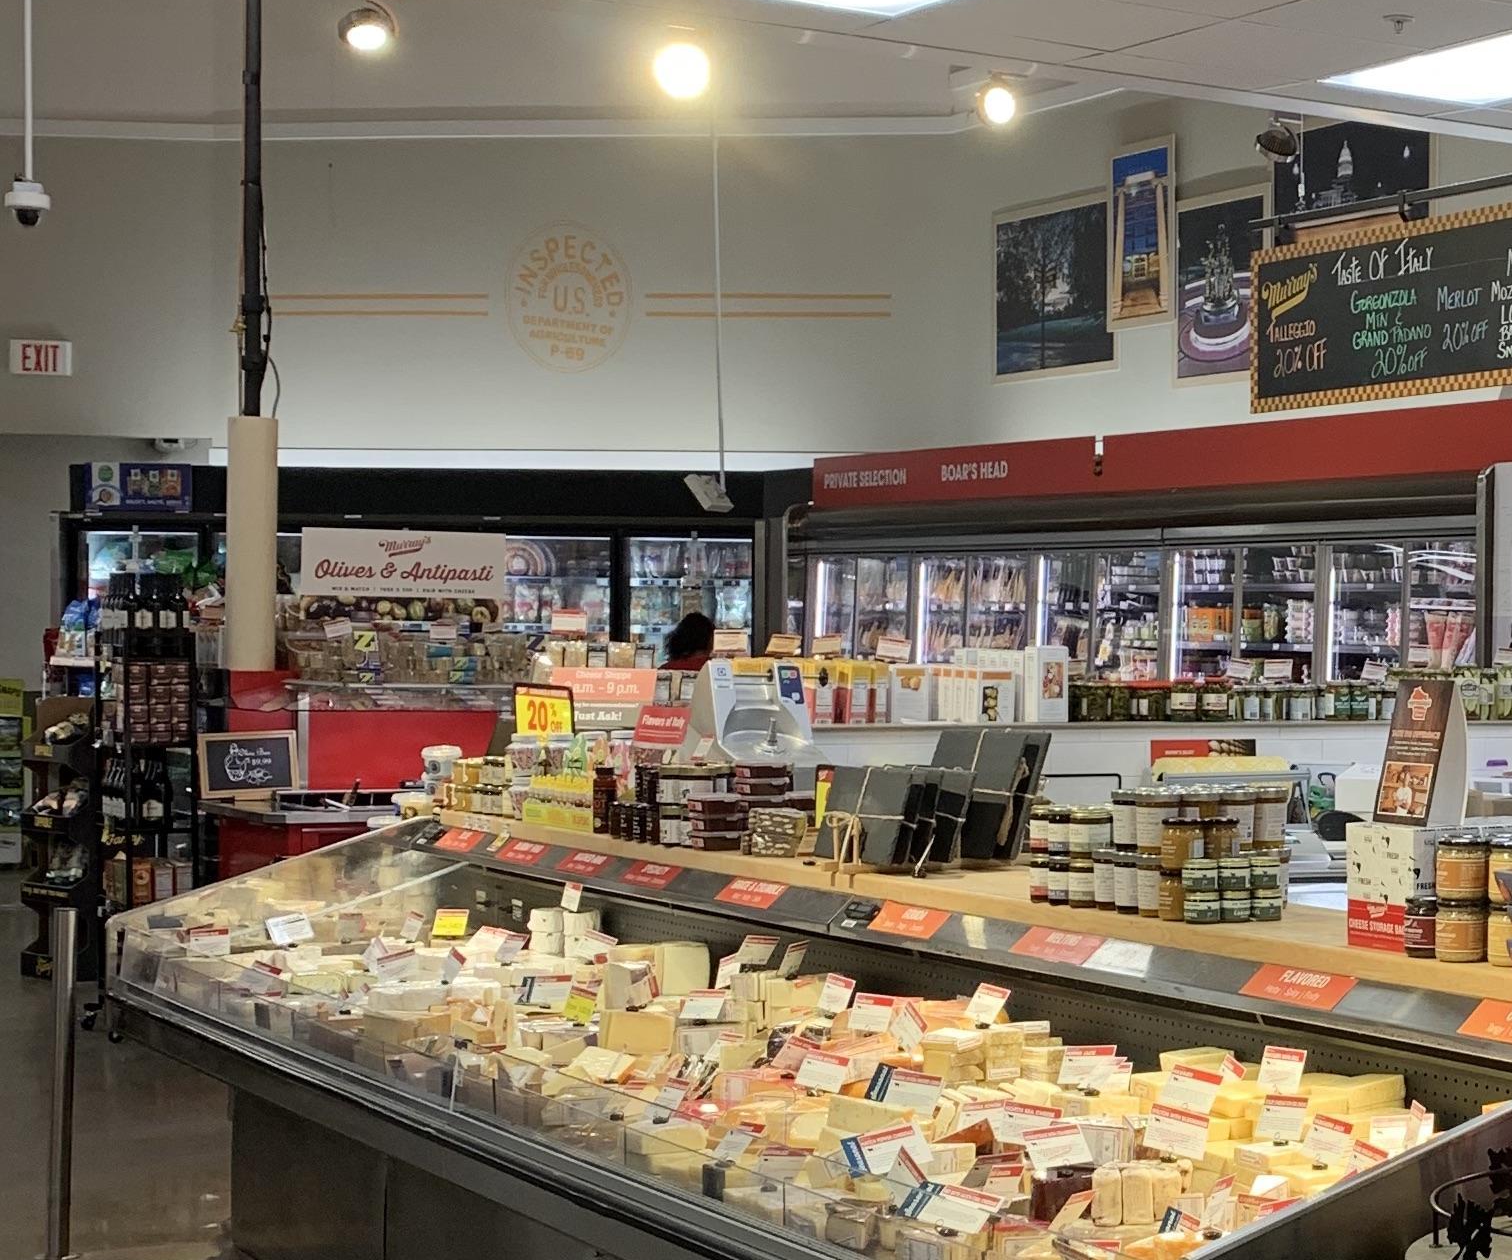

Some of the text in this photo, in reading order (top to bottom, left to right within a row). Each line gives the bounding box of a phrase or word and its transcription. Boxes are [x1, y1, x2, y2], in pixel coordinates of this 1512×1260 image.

[515, 234, 624, 307] INSPECTED
[553, 286, 590, 317] U.S.
[1262, 263, 1318, 322] Murray's
[1351, 288, 1417, 314] GORGONZOLA
[1437, 286, 1482, 312] MERLOT
[1353, 324, 1432, 350] GRAND PADANO
[21, 343, 60, 372] EXIT
[1274, 338, 1328, 378] 20% OFF
[1408, 346, 1428, 372] OFF
[824, 468, 907, 489] PRIVATE SELECTION
[941, 460, 1009, 482] BOAR'S HEAD
[379, 536, 432, 558] Murray's
[315, 559, 494, 585] Olives & Antipasti
[527, 699, 548, 732] 20
[597, 710, 622, 722] Ask!
[1348, 917, 1369, 931] CHEESE
[1278, 969, 1331, 990] FLAVORED
